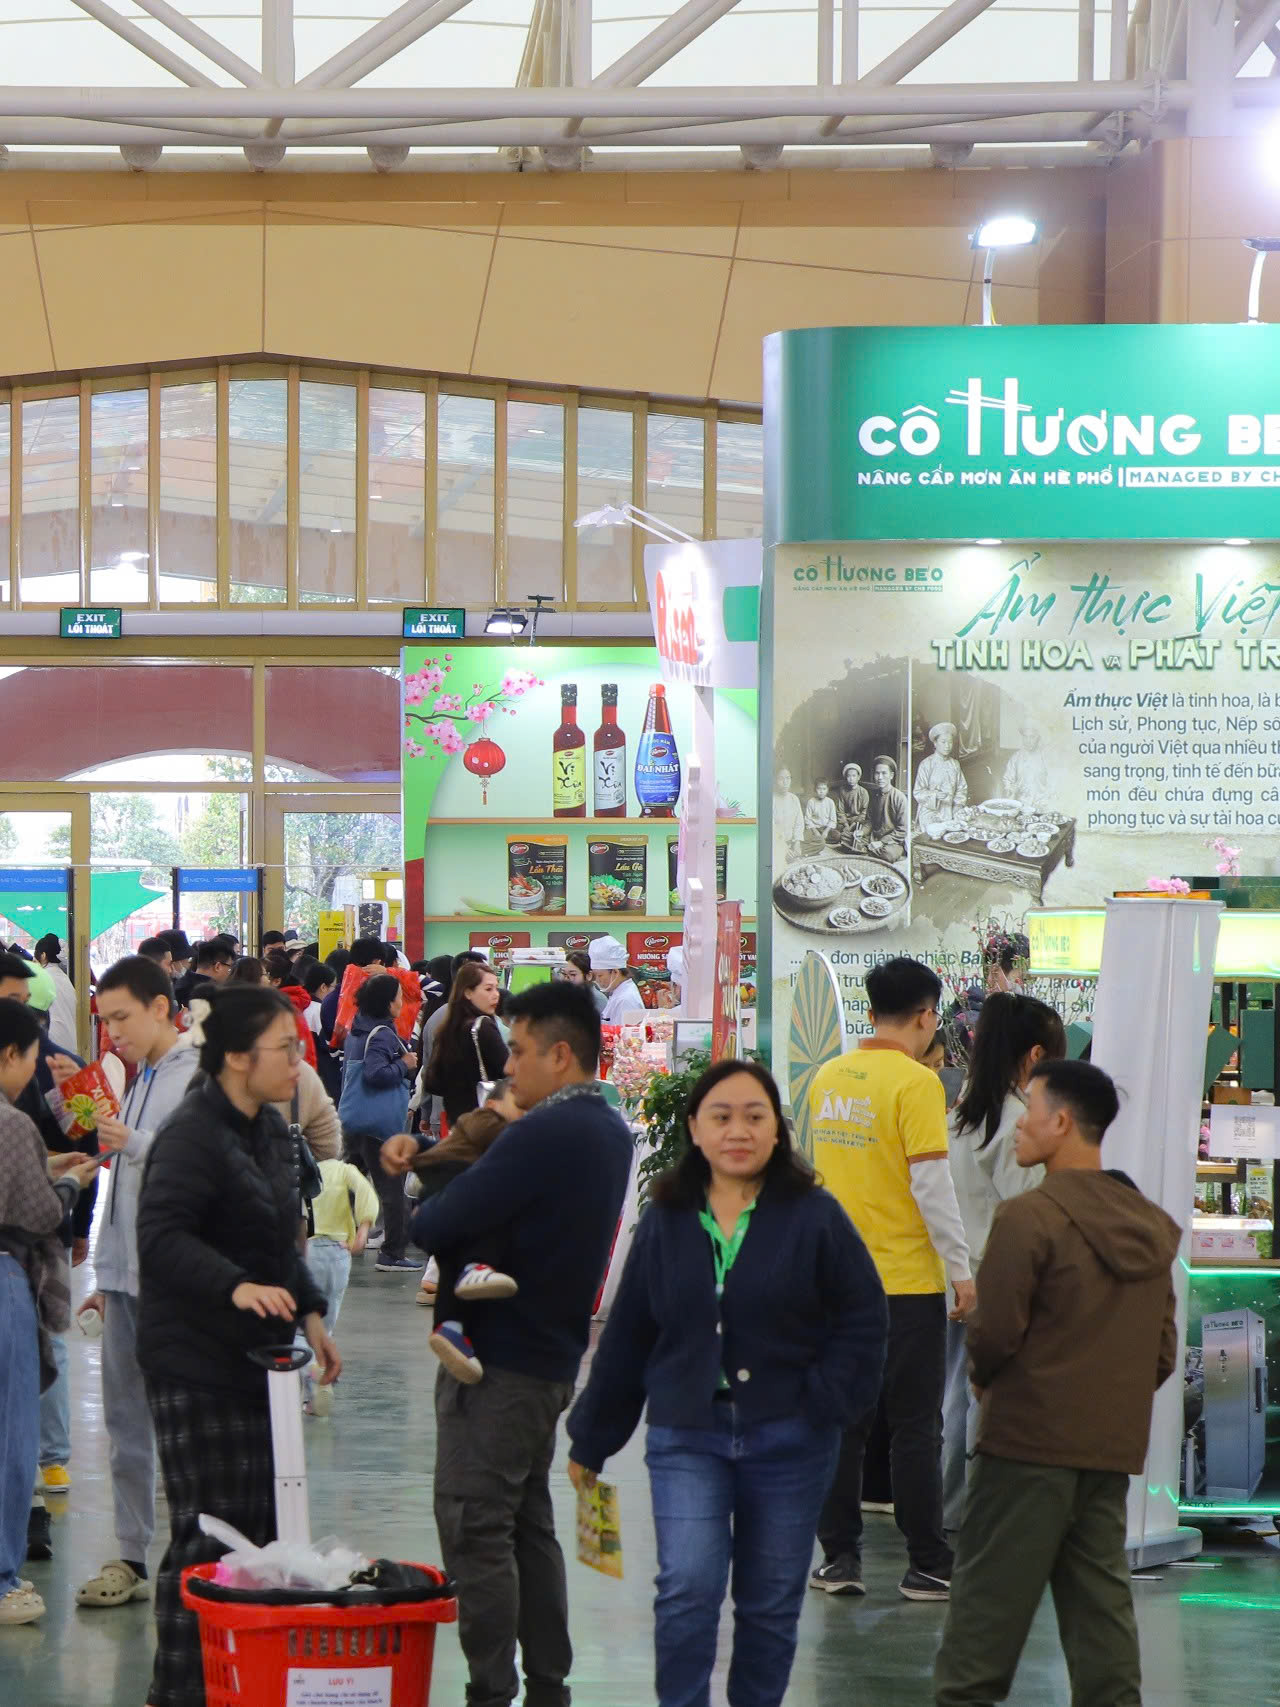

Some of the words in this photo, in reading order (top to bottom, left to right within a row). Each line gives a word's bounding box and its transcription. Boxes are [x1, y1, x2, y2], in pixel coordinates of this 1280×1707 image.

[857, 404, 941, 457] CÔ
[946, 377, 1201, 457] HƯƠNG
[857, 467, 913, 485] NÂNG
[919, 463, 954, 485] CẤP
[1008, 467, 1038, 485] ĂN
[1077, 463, 1113, 485] PHỐ
[1130, 471, 1223, 483] MANAGED
[1231, 471, 1252, 483] BY
[793, 564, 819, 582] CÔ
[1068, 572, 1172, 635] thực
[76, 613, 106, 622] EXIT
[420, 613, 449, 622] EXIT
[67, 621, 83, 634] LỐI
[84, 622, 113, 634] THOÁT
[411, 621, 426, 634] LỐI
[427, 622, 457, 634] THOÁT
[930, 639, 1009, 671] TINH
[1022, 639, 1094, 671] HOA
[1129, 631, 1221, 671] PHÁT
[1095, 692, 1133, 711] thực
[1136, 691, 1168, 711] Việt
[1172, 692, 1185, 708] là
[1189, 692, 1218, 708] tinh
[1221, 692, 1254, 710] hoa,
[1258, 691, 1271, 708] là
[1072, 716, 1104, 733] Lịch
[1108, 714, 1132, 733] sử,
[1137, 716, 1187, 735] Phong
[1192, 717, 1220, 734] tục,
[1226, 714, 1258, 735] Nếp
[1078, 738, 1106, 754] của
[1110, 739, 1154, 758] người
[1157, 739, 1188, 757] Việt
[1192, 743, 1220, 758] qua
[1224, 738, 1267, 755] nhiều
[1083, 766, 1120, 781] sang
[1124, 764, 1169, 782] trọng,
[1172, 763, 1201, 778] tinh
[1205, 761, 1222, 778] tế
[1224, 761, 1253, 778] đến
[1086, 785, 1120, 801] món
[1128, 786, 1158, 801] đều
[1165, 786, 1204, 801] chứa
[1212, 786, 1253, 805] đựng
[1088, 810, 1137, 828] phong
[1140, 812, 1165, 828] tục
[1169, 809, 1186, 825] và
[1190, 812, 1210, 828] sự
[1213, 809, 1232, 825] tài
[1235, 810, 1264, 825] hoa
[830, 950, 860, 964] đơn
[961, 950, 982, 965] Bá
[843, 974, 865, 988] tru
[845, 1019, 874, 1035] bữa
